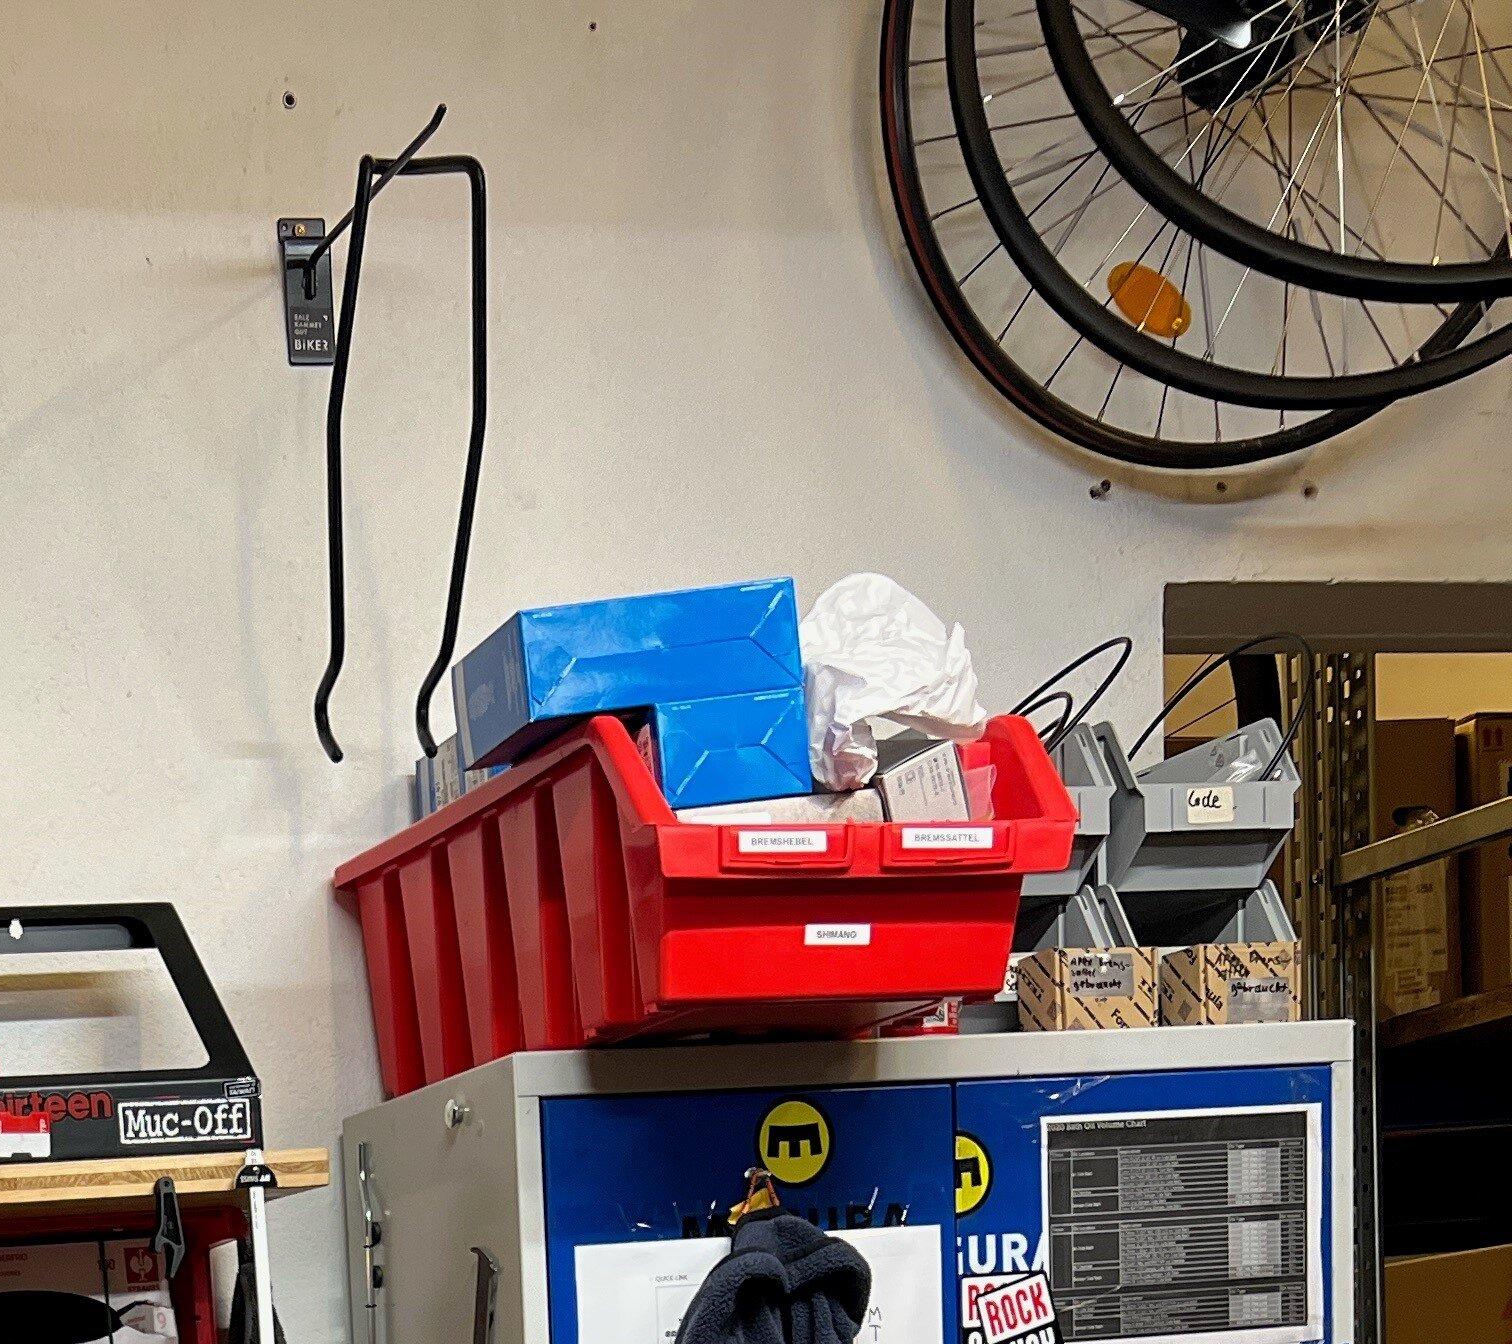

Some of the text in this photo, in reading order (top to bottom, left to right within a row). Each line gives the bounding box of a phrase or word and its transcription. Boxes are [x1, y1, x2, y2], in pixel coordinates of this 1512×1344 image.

[1188, 788, 1223, 811] Code
[751, 837, 814, 847] BREMSHEBEL
[914, 834, 980, 843] BREMSSATTEL
[816, 930, 857, 939] SHIMANO
[125, 1101, 248, 1138] Muc-Off
[1097, 1120, 1125, 1129] Volume
[1126, 1119, 1148, 1128] Chart
[984, 1281, 1049, 1337] ROCK
